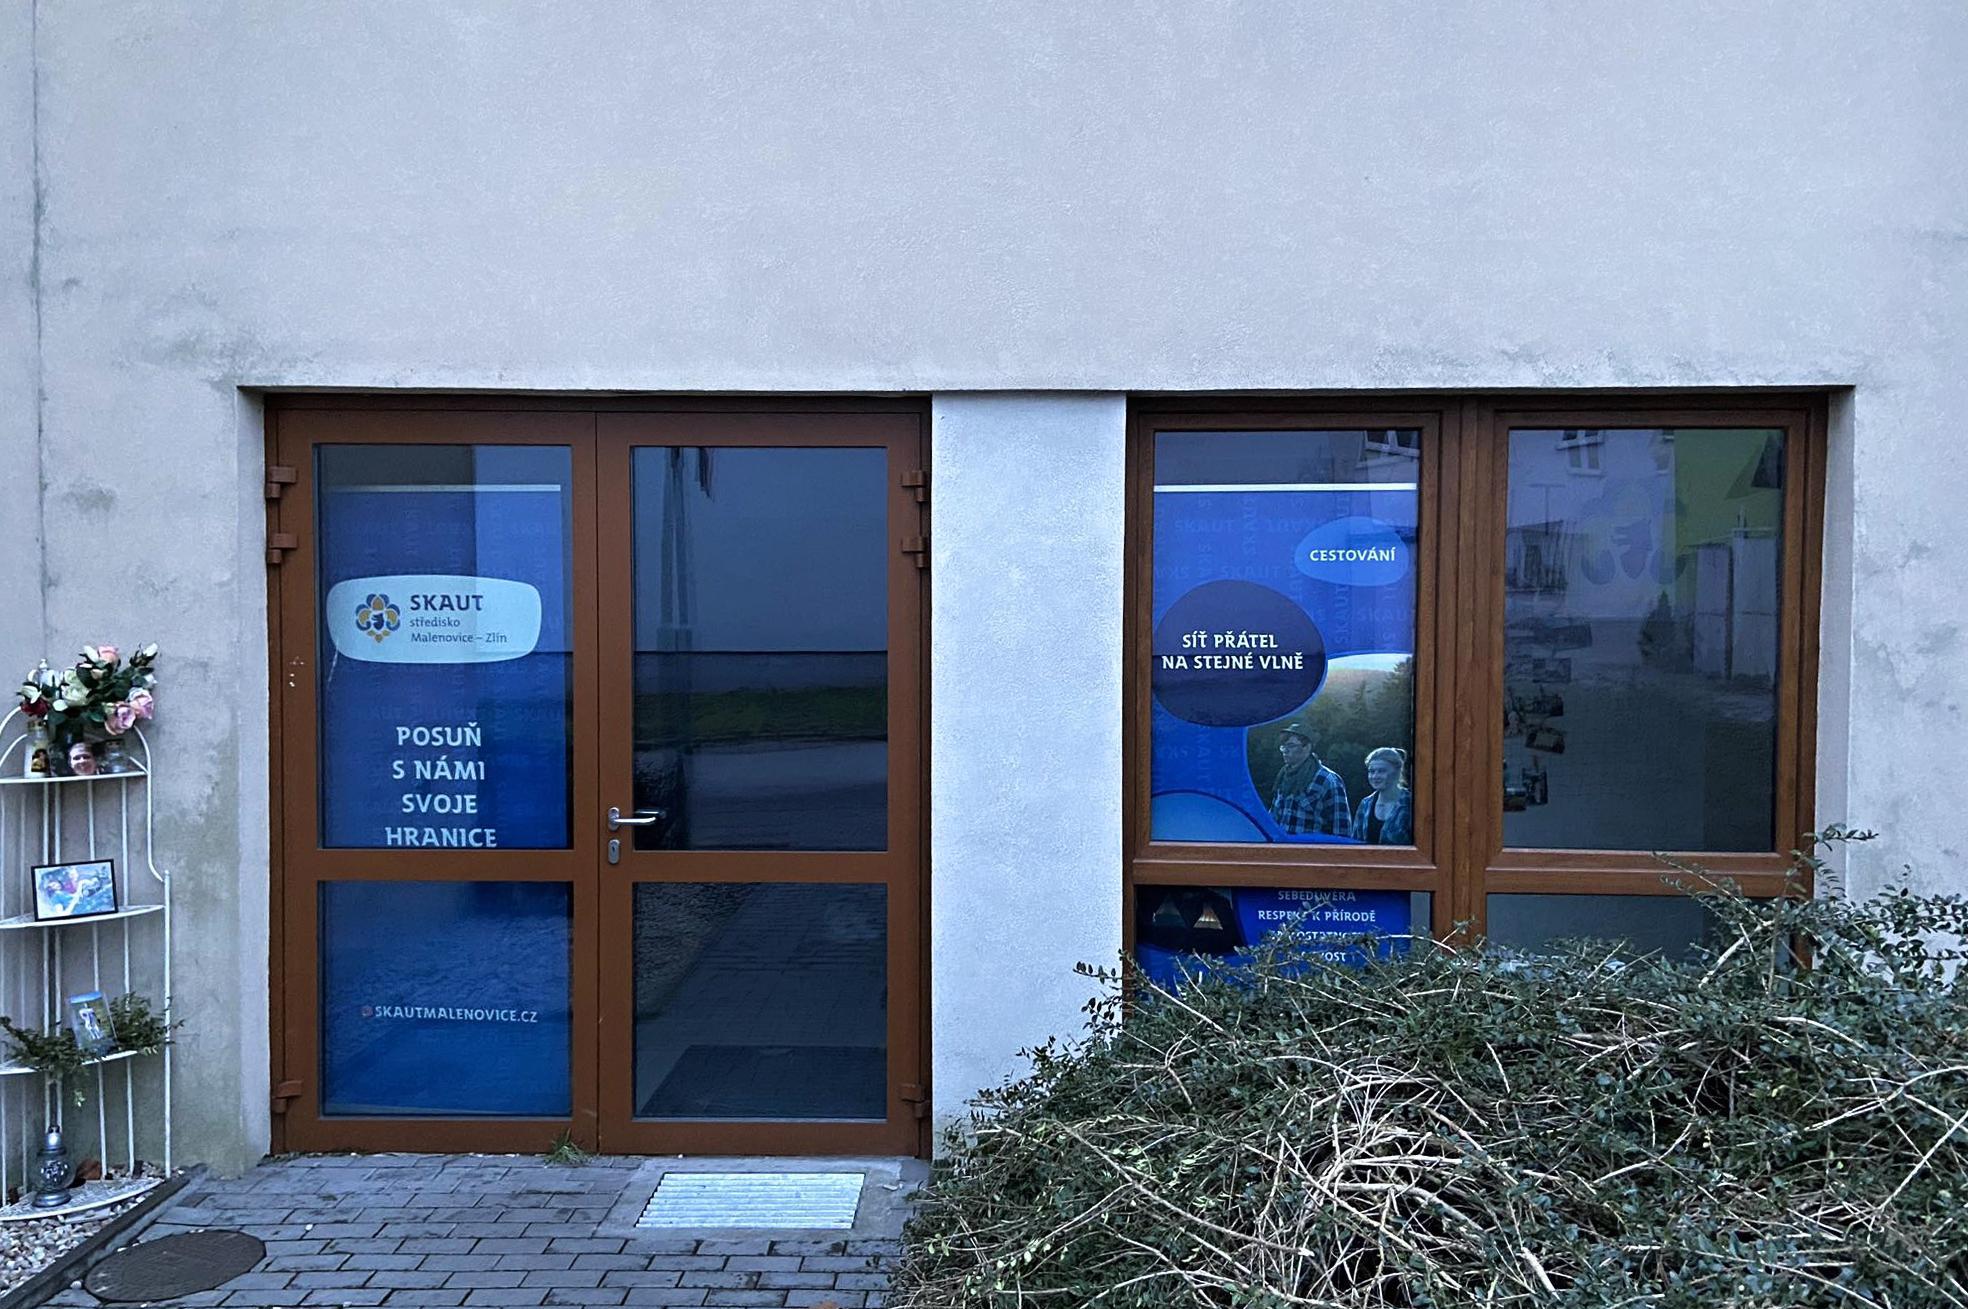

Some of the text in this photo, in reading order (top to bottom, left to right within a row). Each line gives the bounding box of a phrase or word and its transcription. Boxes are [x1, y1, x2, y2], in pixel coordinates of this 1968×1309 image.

[1309, 546, 1397, 562] CESTOVÁNÍ
[410, 594, 484, 611] SKAUT
[409, 616, 461, 628] středisko
[411, 632, 473, 643] Malenovice
[485, 632, 508, 643] Zlín
[1182, 630, 1278, 648] SÍŤ PŘÁTEL
[1161, 651, 1304, 670] NA STEJNÉ VLNĚ
[396, 721, 481, 747] POSUŇ
[392, 755, 485, 780] S NÁMI
[402, 793, 478, 814] SVOJE
[384, 826, 498, 848] HRANICE
[1324, 908, 1376, 922] PŘÍRODĚ
[375, 1005, 538, 1023] SKAUTMALENOVICE.CZ
